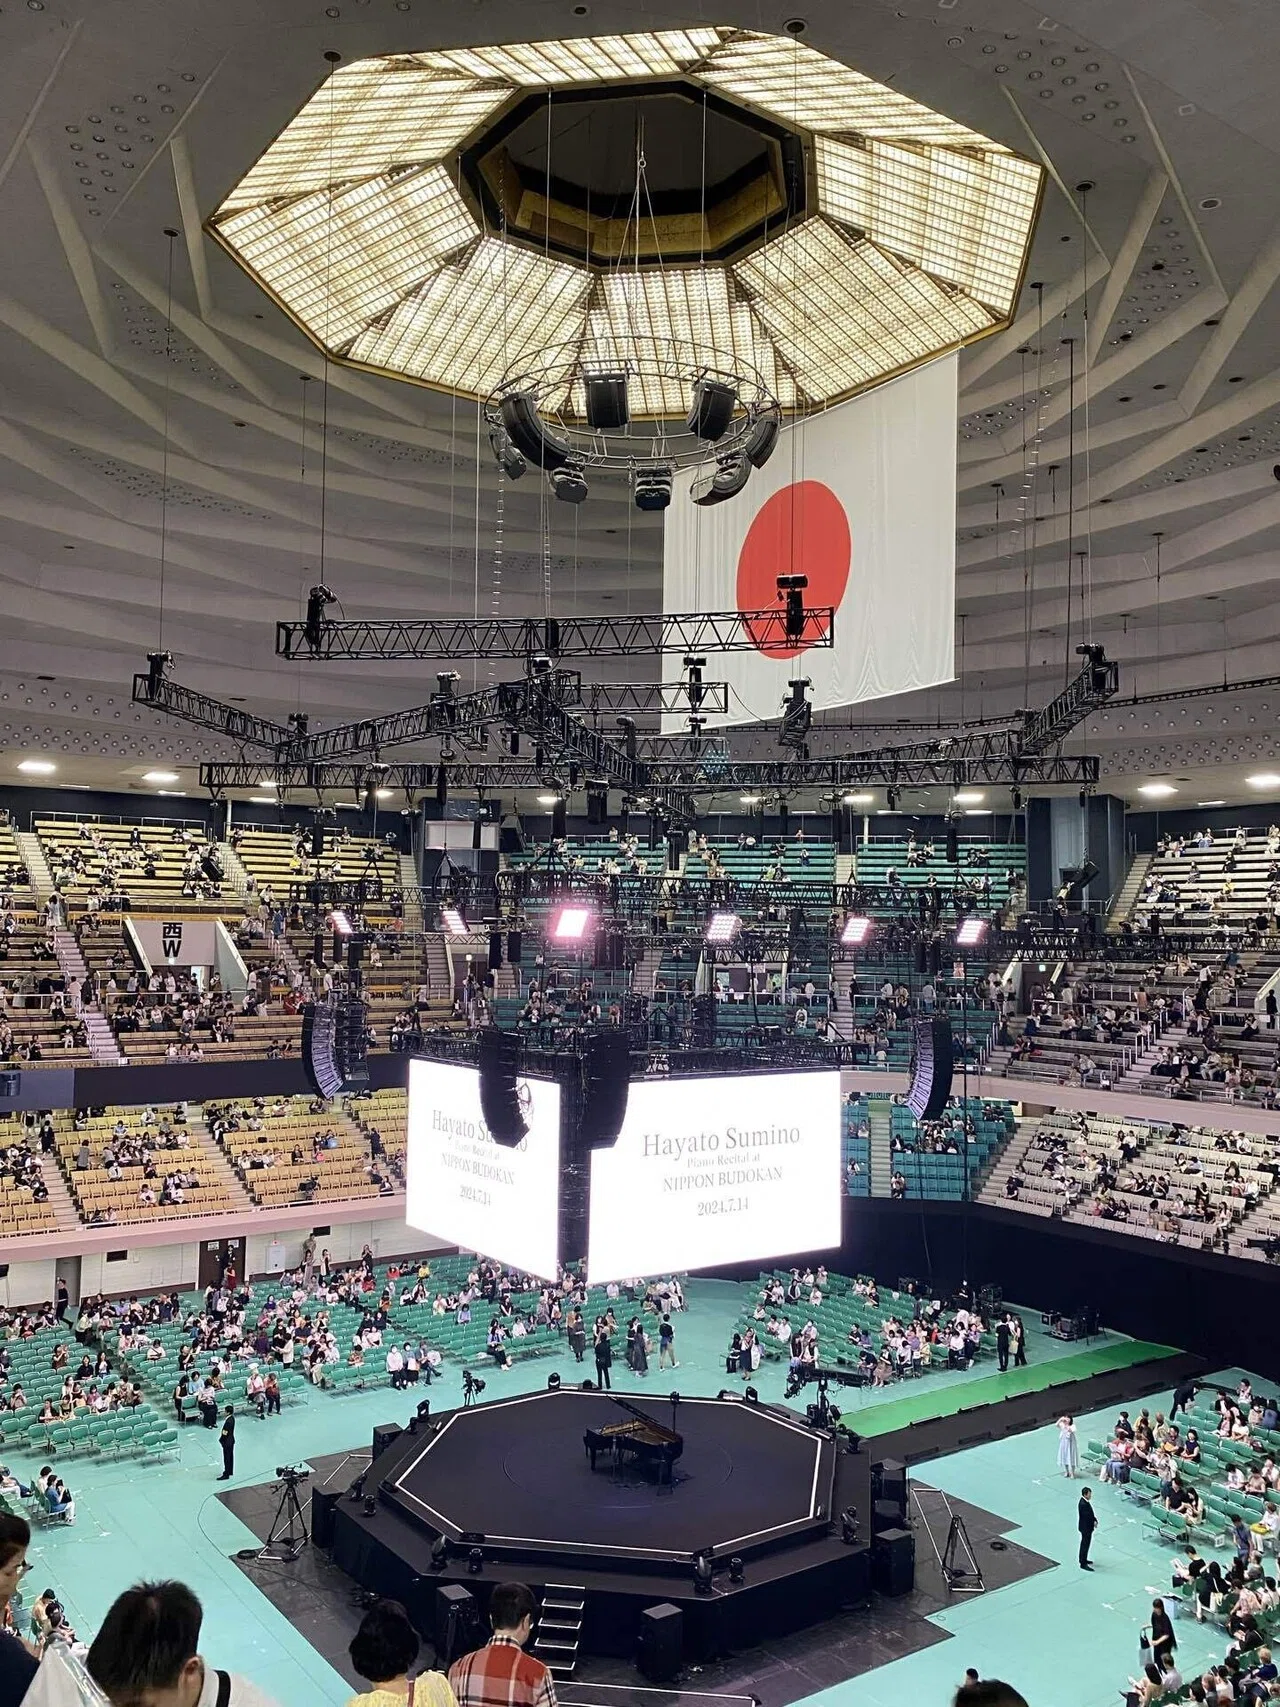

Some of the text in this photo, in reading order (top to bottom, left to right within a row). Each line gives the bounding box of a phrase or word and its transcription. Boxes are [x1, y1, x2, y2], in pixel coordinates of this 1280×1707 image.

[162, 922, 183, 939] 西
[162, 940, 182, 958] W
[432, 1109, 528, 1152] Hayato Suo
[642, 1124, 801, 1161] Hayato Sumino
[441, 1152, 515, 1185] NIPPON BUDOKAN
[687, 1152, 761, 1168] Piano Recital at
[663, 1166, 783, 1192] NIPPON BUDOKAN
[459, 1184, 491, 1206] 2024.7.14
[697, 1197, 749, 1216] 2024.7.14
